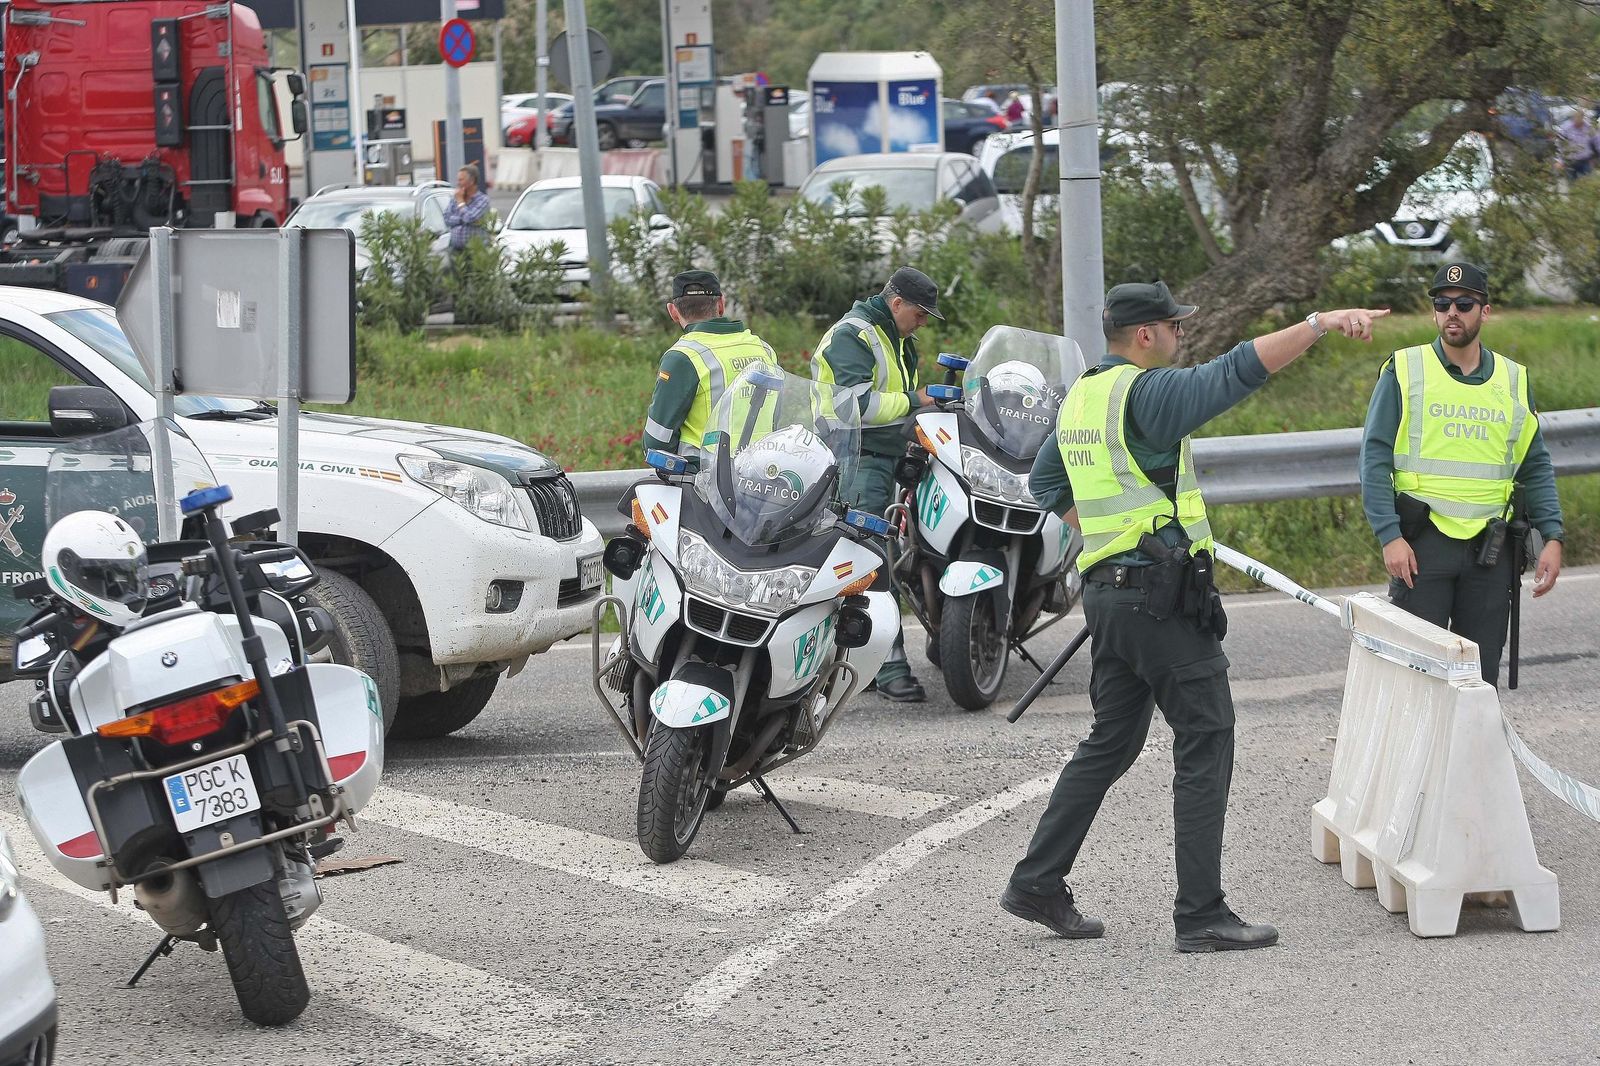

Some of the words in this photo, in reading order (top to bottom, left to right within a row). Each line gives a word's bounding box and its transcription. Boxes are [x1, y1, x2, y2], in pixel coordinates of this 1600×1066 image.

[999, 406, 1050, 426] TRAFICO
[1429, 402, 1507, 424] GUARDIA
[1059, 428, 1102, 446] GUARDIA
[1443, 422, 1490, 441] CIVIL
[248, 459, 315, 471] GUAIA
[320, 463, 357, 475] CIVIL
[1067, 449, 1095, 467] CIVIL
[737, 476, 801, 501] TRAFICO
[184, 766, 226, 797] PGC
[227, 758, 246, 783] K
[194, 787, 249, 822] 7383
